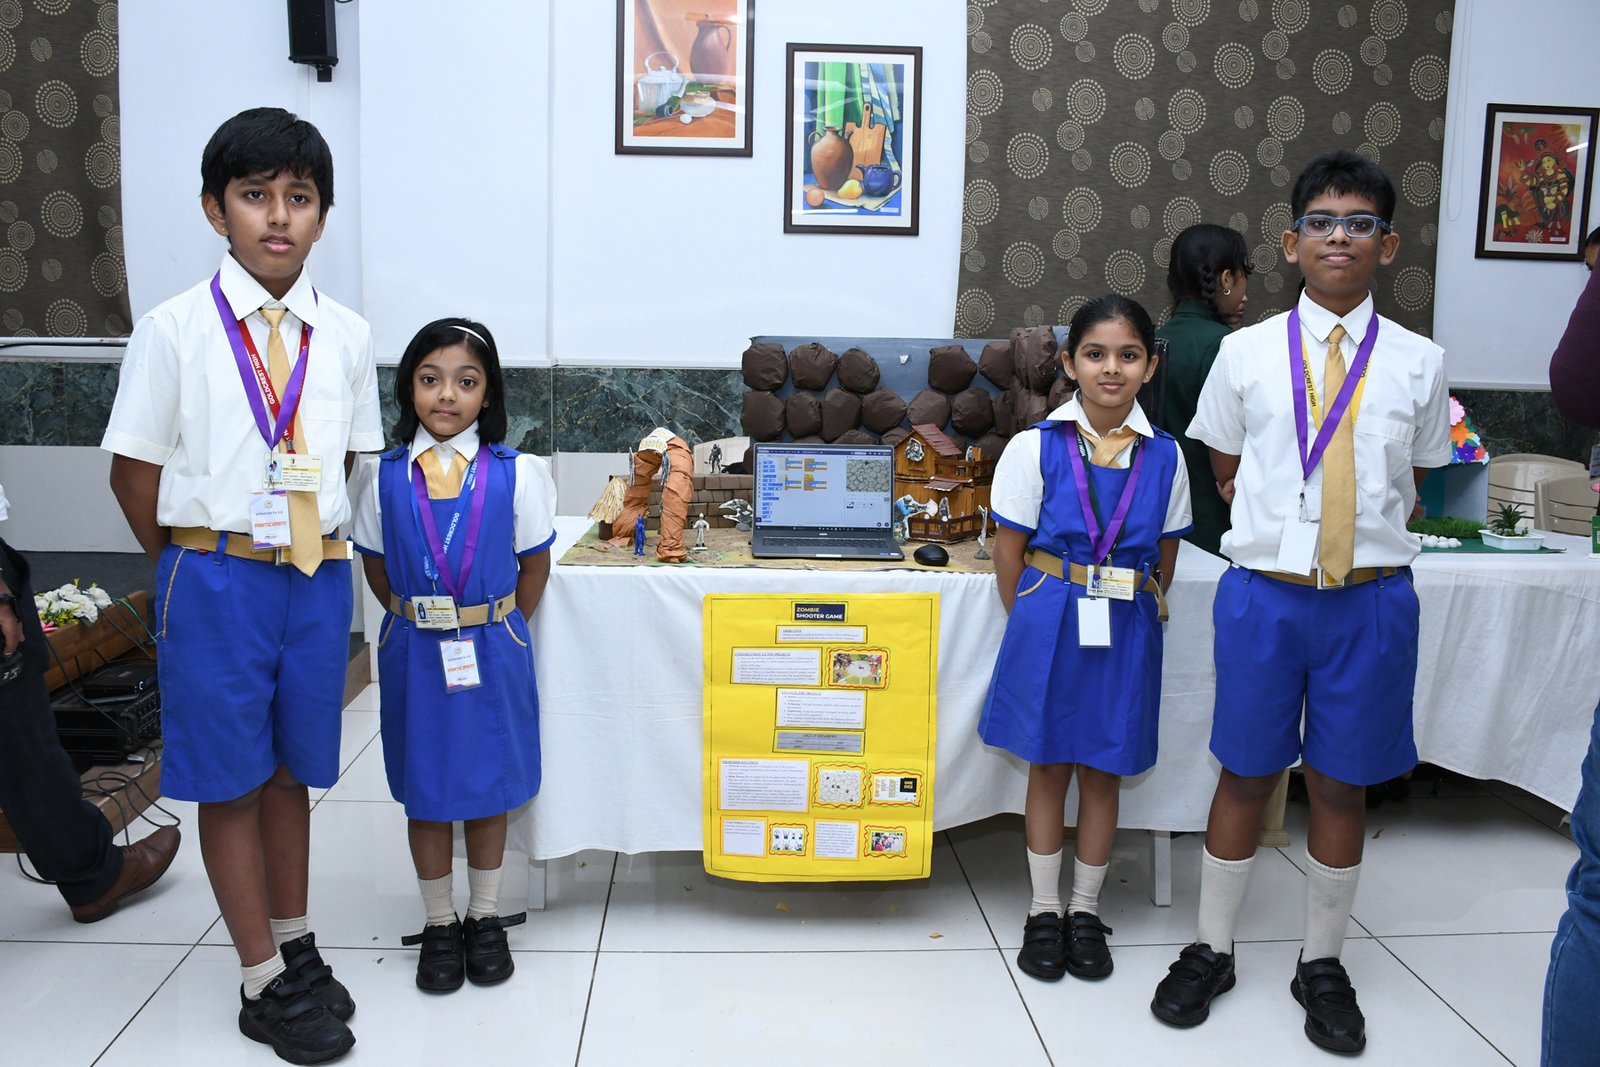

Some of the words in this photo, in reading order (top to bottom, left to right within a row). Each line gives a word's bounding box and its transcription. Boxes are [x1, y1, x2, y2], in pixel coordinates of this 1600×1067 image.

[251, 353, 261, 369] HIGH
[257, 369, 275, 405] GOLDCREST
[1309, 391, 1317, 407] HIGH
[445, 512, 460, 546] GOLDCREST
